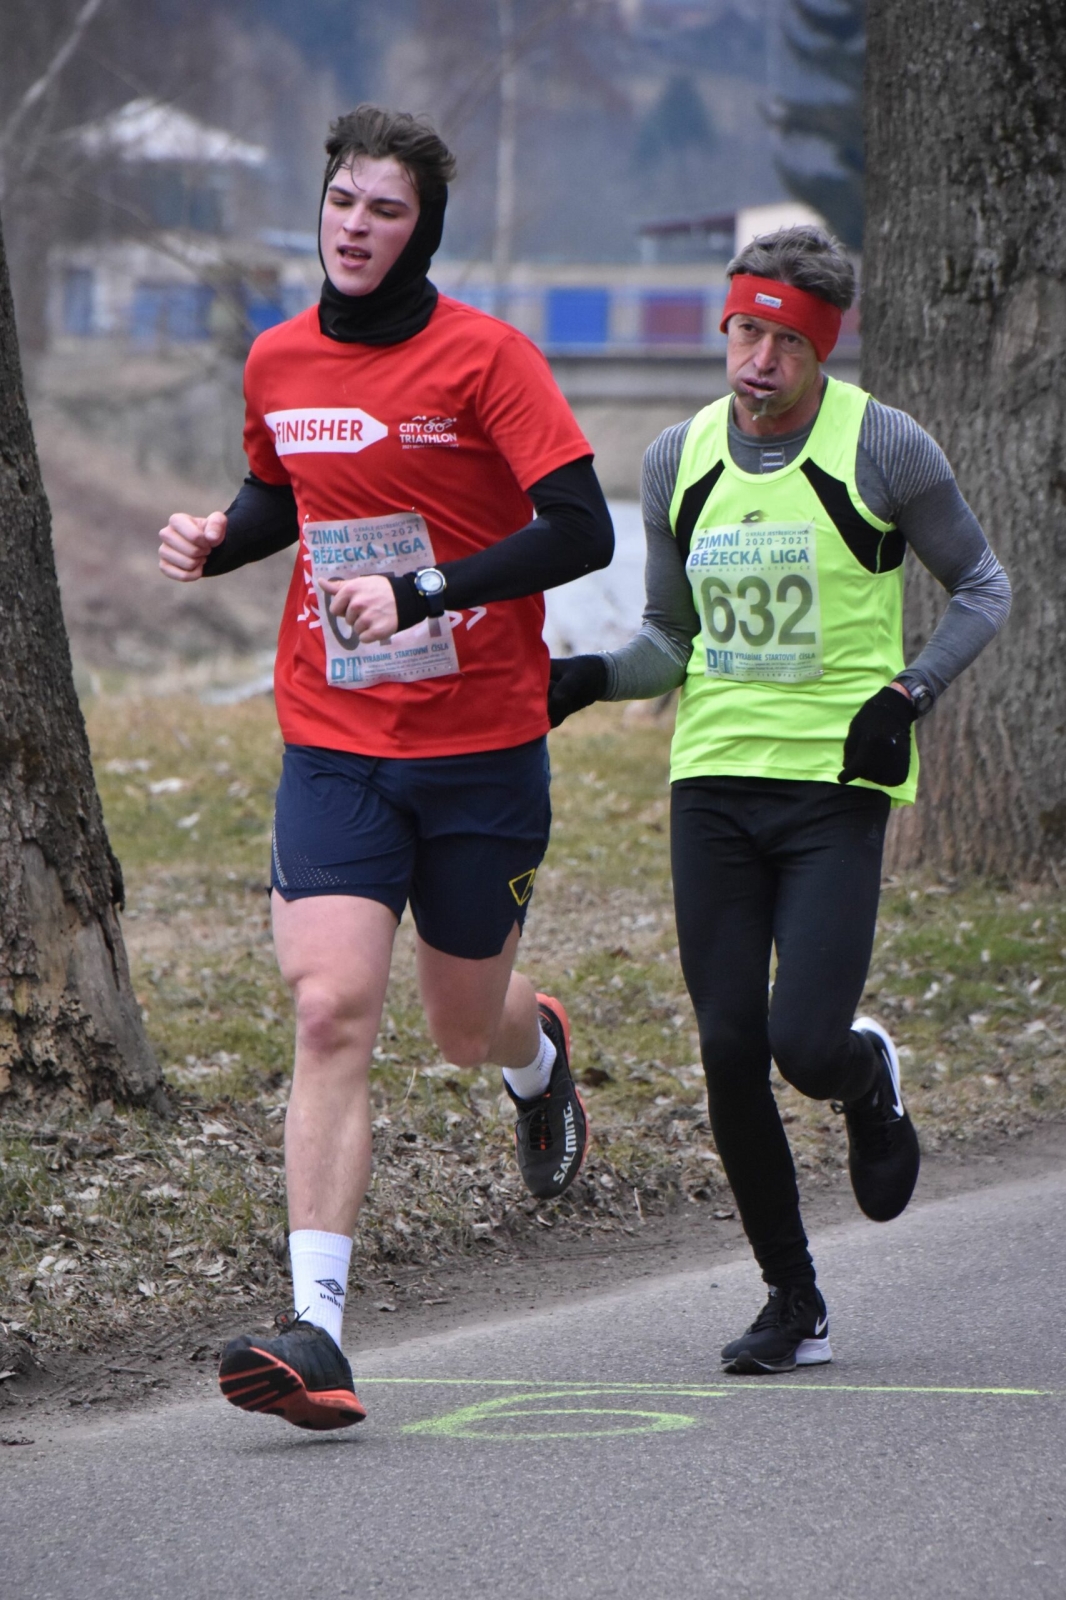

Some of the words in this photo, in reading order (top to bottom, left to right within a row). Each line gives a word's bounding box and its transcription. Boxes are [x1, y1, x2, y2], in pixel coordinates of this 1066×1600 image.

[276, 419, 363, 443] FINISHER
[399, 423, 423, 433] CITY
[399, 433, 457, 443] TRIATHLON
[309, 526, 350, 545] ZIMNÍ
[355, 524, 420, 542] 2020-2021
[695, 529, 741, 550] ZIMNÍ
[745, 536, 808, 546] 2020-2021
[313, 542, 378, 566] BĚŽECKÁ
[384, 537, 426, 557] LIGA
[690, 547, 762, 566] BĚŽECKÁ
[771, 549, 809, 564] LIGA
[701, 575, 816, 646] 632
